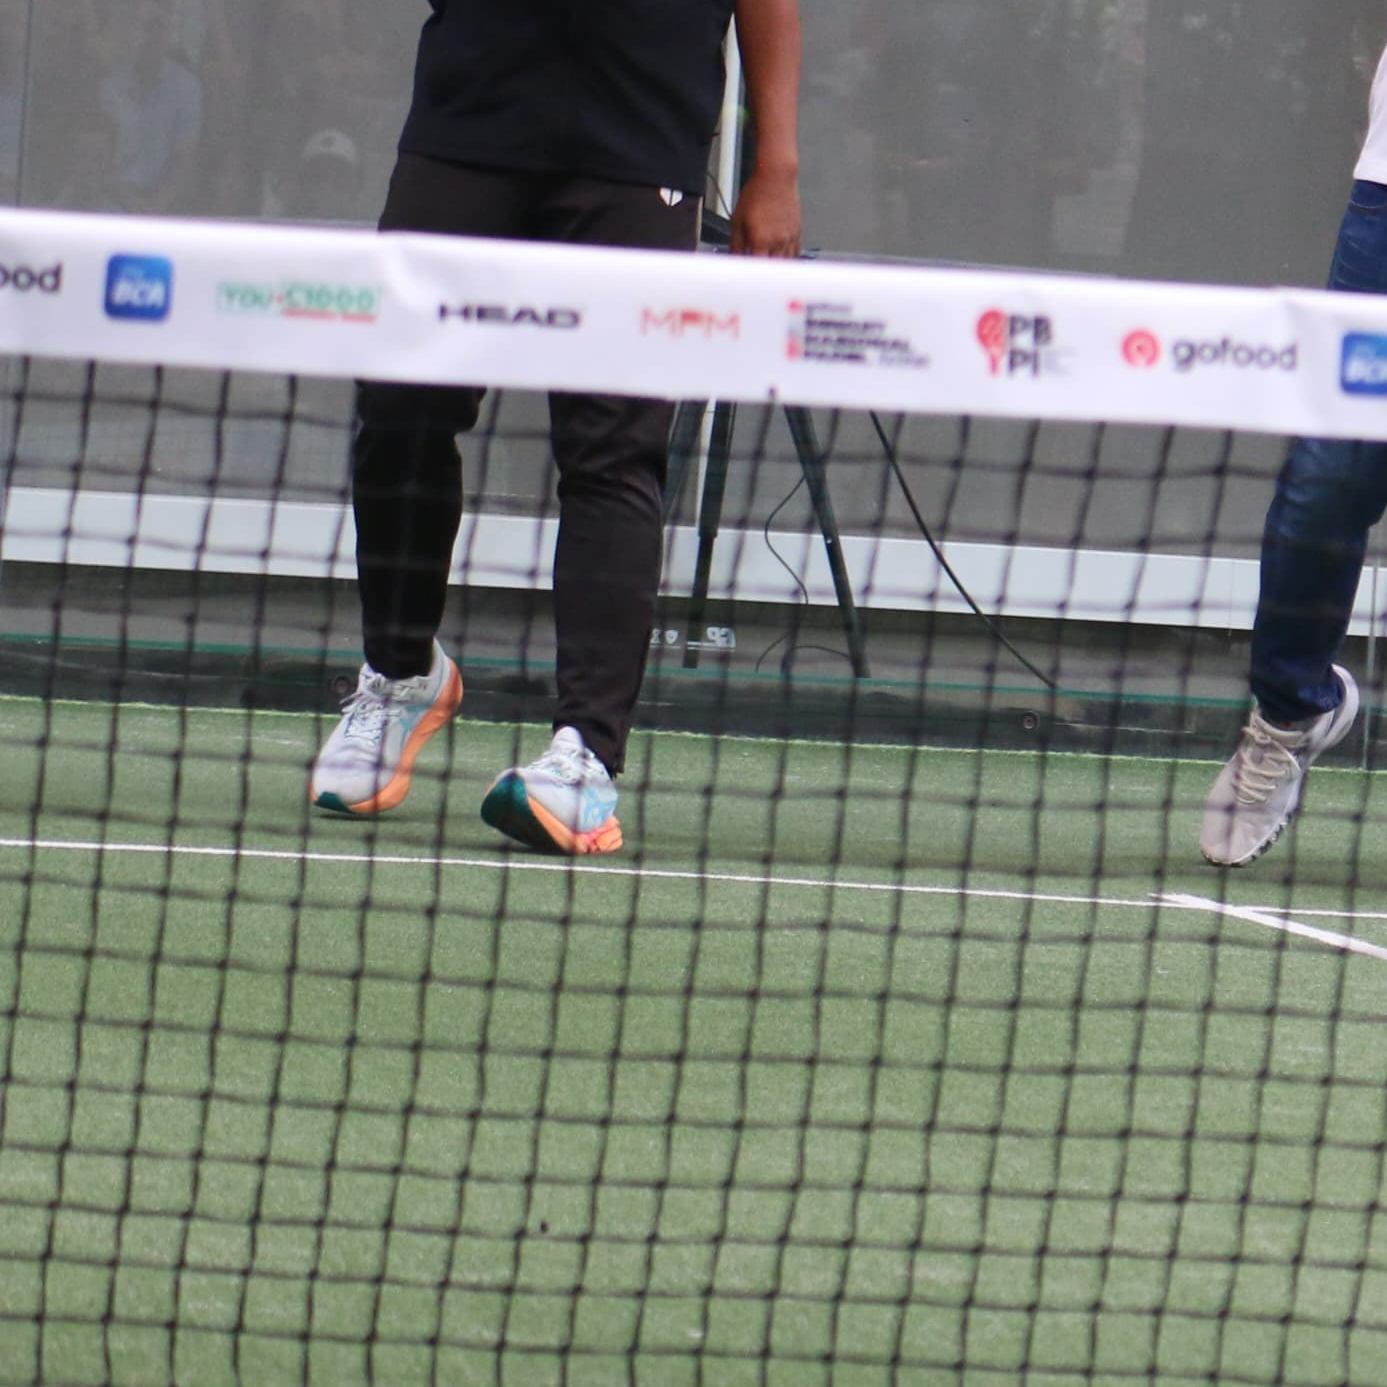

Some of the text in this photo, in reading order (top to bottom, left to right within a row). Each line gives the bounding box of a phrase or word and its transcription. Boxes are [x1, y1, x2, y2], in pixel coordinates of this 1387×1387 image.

[438, 302, 582, 329] HEAD
[1008, 314, 1053, 346] PB
[1007, 348, 1041, 378] PI
[1172, 334, 1299, 373] gofood
